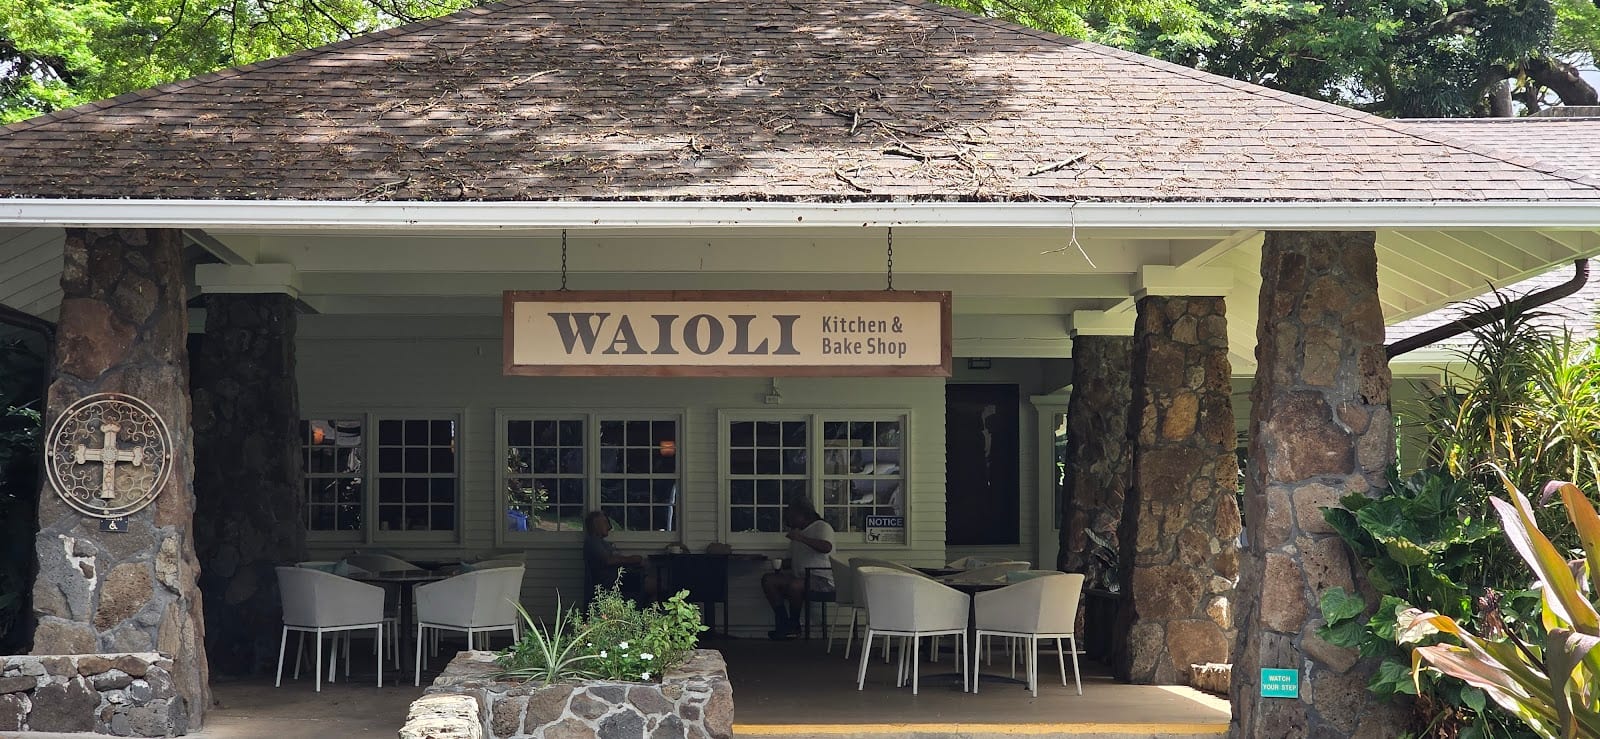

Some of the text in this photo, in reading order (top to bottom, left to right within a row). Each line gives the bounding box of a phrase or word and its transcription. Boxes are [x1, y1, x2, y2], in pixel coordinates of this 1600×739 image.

[547, 312, 801, 355] WAIOLI
[822, 315, 903, 333] Kitchen &
[822, 337, 907, 359] Bake Shop
[868, 518, 903, 526] NOTICE
